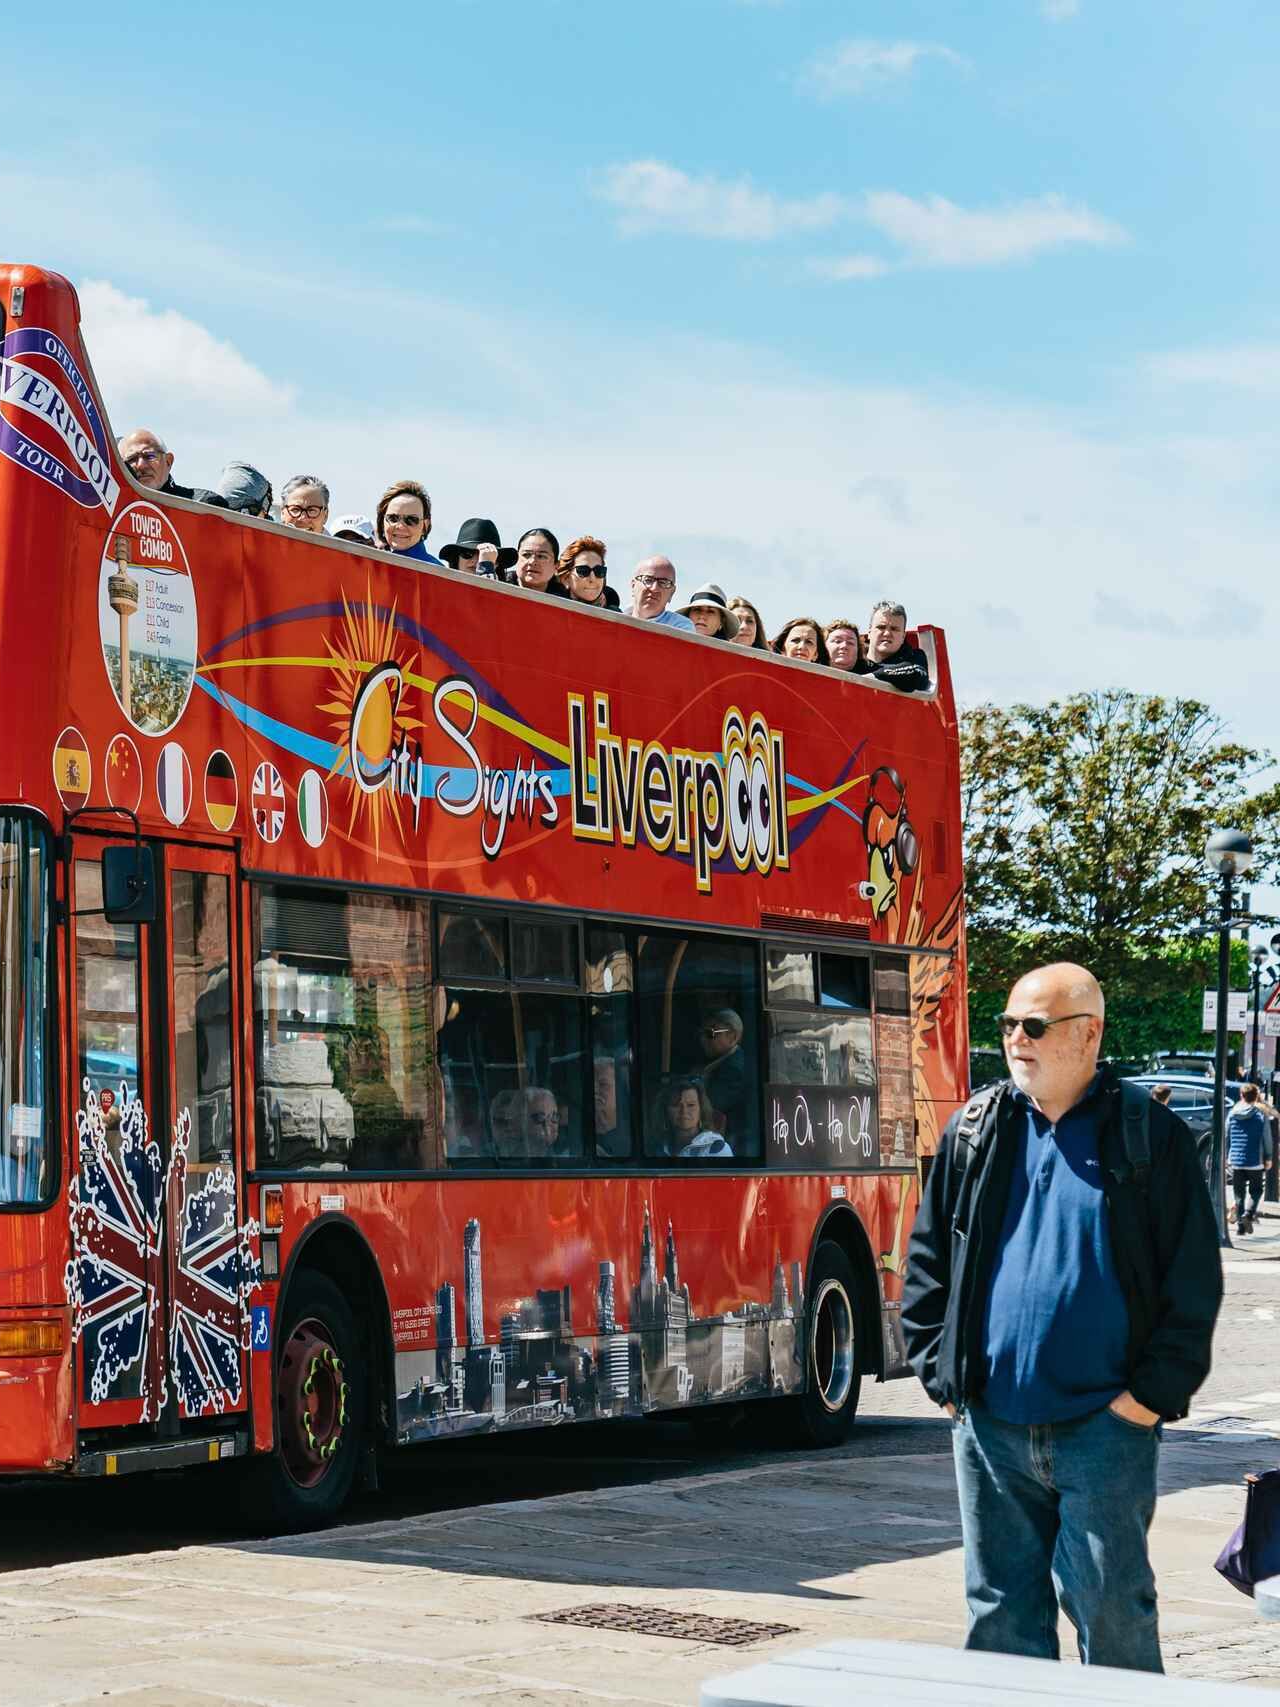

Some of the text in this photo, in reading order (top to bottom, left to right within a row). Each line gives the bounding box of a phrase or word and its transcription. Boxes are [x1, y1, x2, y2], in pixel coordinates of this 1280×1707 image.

[45, 337, 94, 416] OFFICIAL
[15, 440, 65, 484] TOUR
[130, 512, 162, 539] TOWER
[140, 536, 173, 562] COMBO
[350, 660, 559, 862] City Sights
[568, 690, 790, 892] Liverpool
[773, 1098, 789, 1154] Hop
[794, 1096, 814, 1146] On
[828, 1099, 843, 1153] Hop
[848, 1096, 872, 1157] Off
